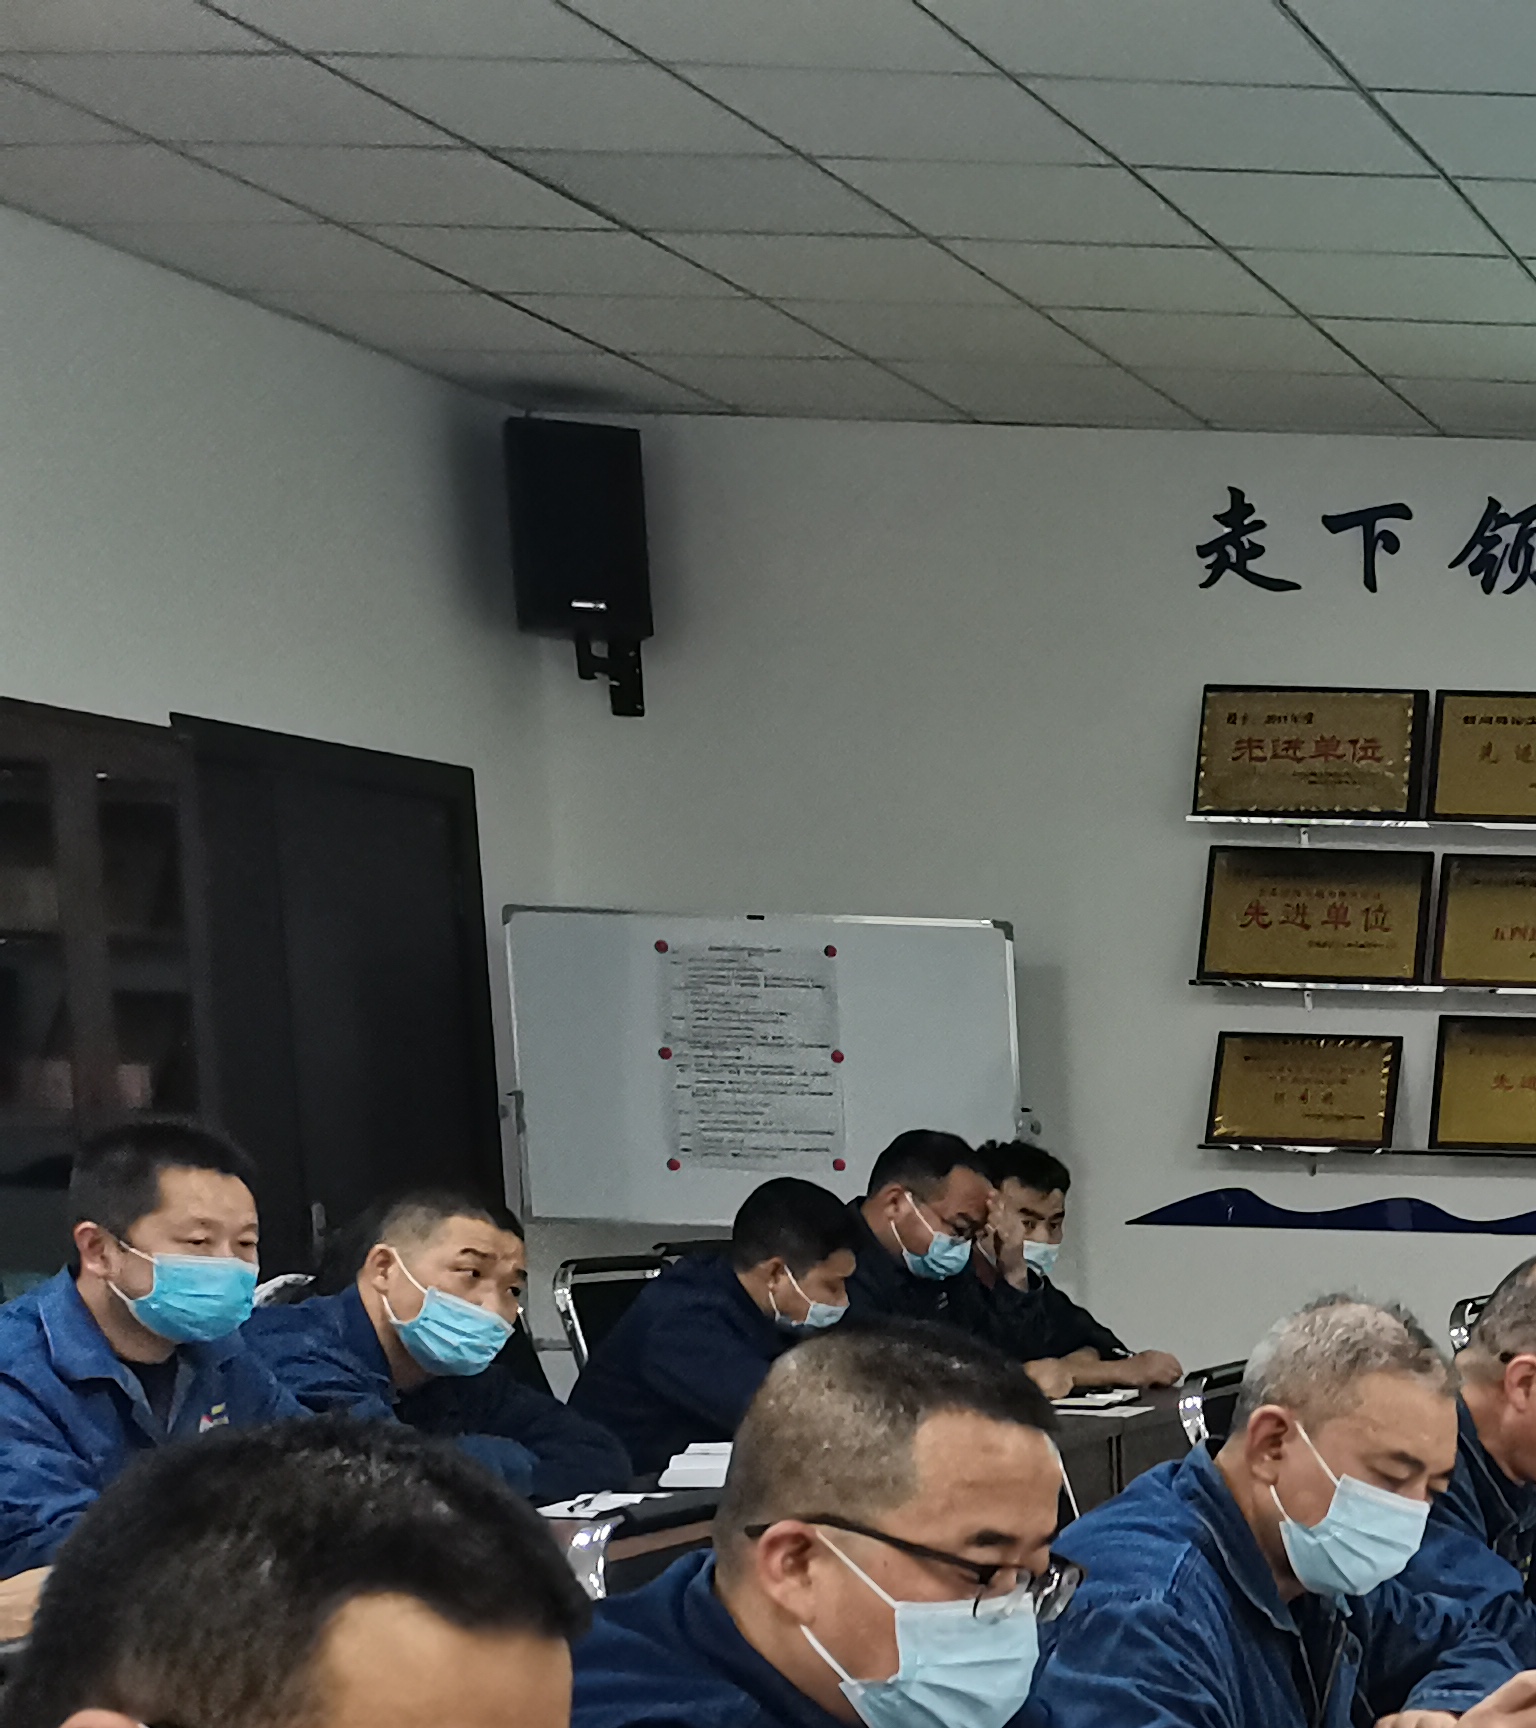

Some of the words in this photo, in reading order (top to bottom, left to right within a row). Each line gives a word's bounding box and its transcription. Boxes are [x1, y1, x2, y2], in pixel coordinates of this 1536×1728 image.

[1231, 735, 1384, 765] 先进单位
[1238, 899, 1393, 933] 先进单位
